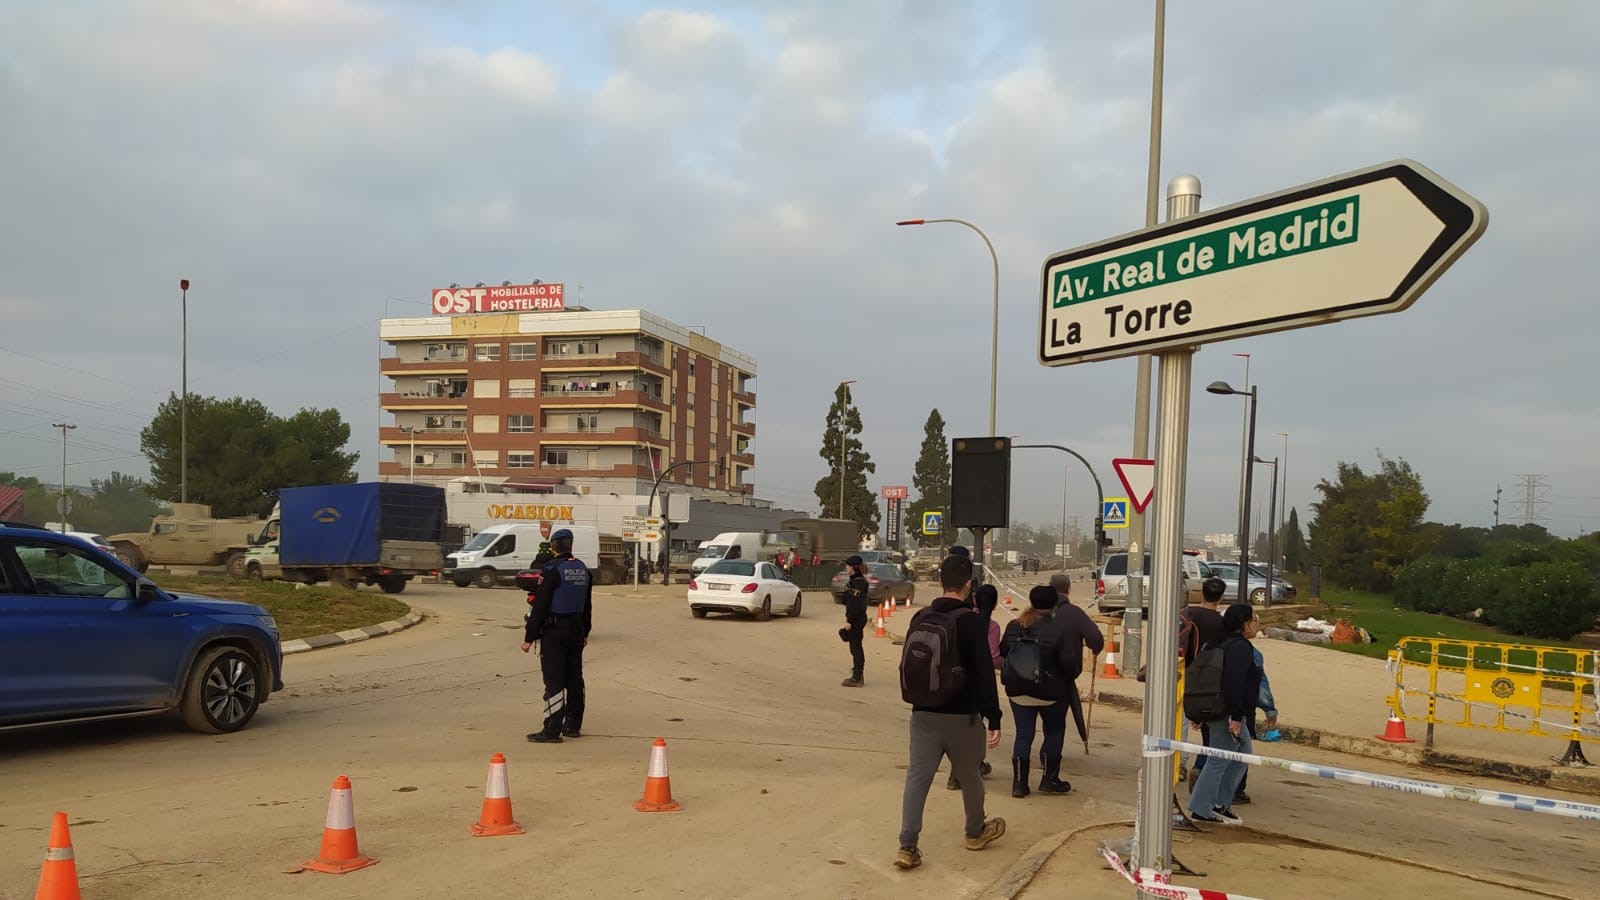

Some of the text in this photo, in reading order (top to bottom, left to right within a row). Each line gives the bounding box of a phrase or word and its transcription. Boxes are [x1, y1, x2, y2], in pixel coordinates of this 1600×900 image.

[1055, 202, 1354, 303] Av. Real de Madrid
[490, 285, 563, 298] MOBILIARIO DE
[434, 288, 487, 314] OST
[490, 297, 562, 311] HOSTELERIA
[1050, 299, 1192, 348] La Torre
[885, 489, 903, 497] OST
[487, 503, 575, 521] OCASION
